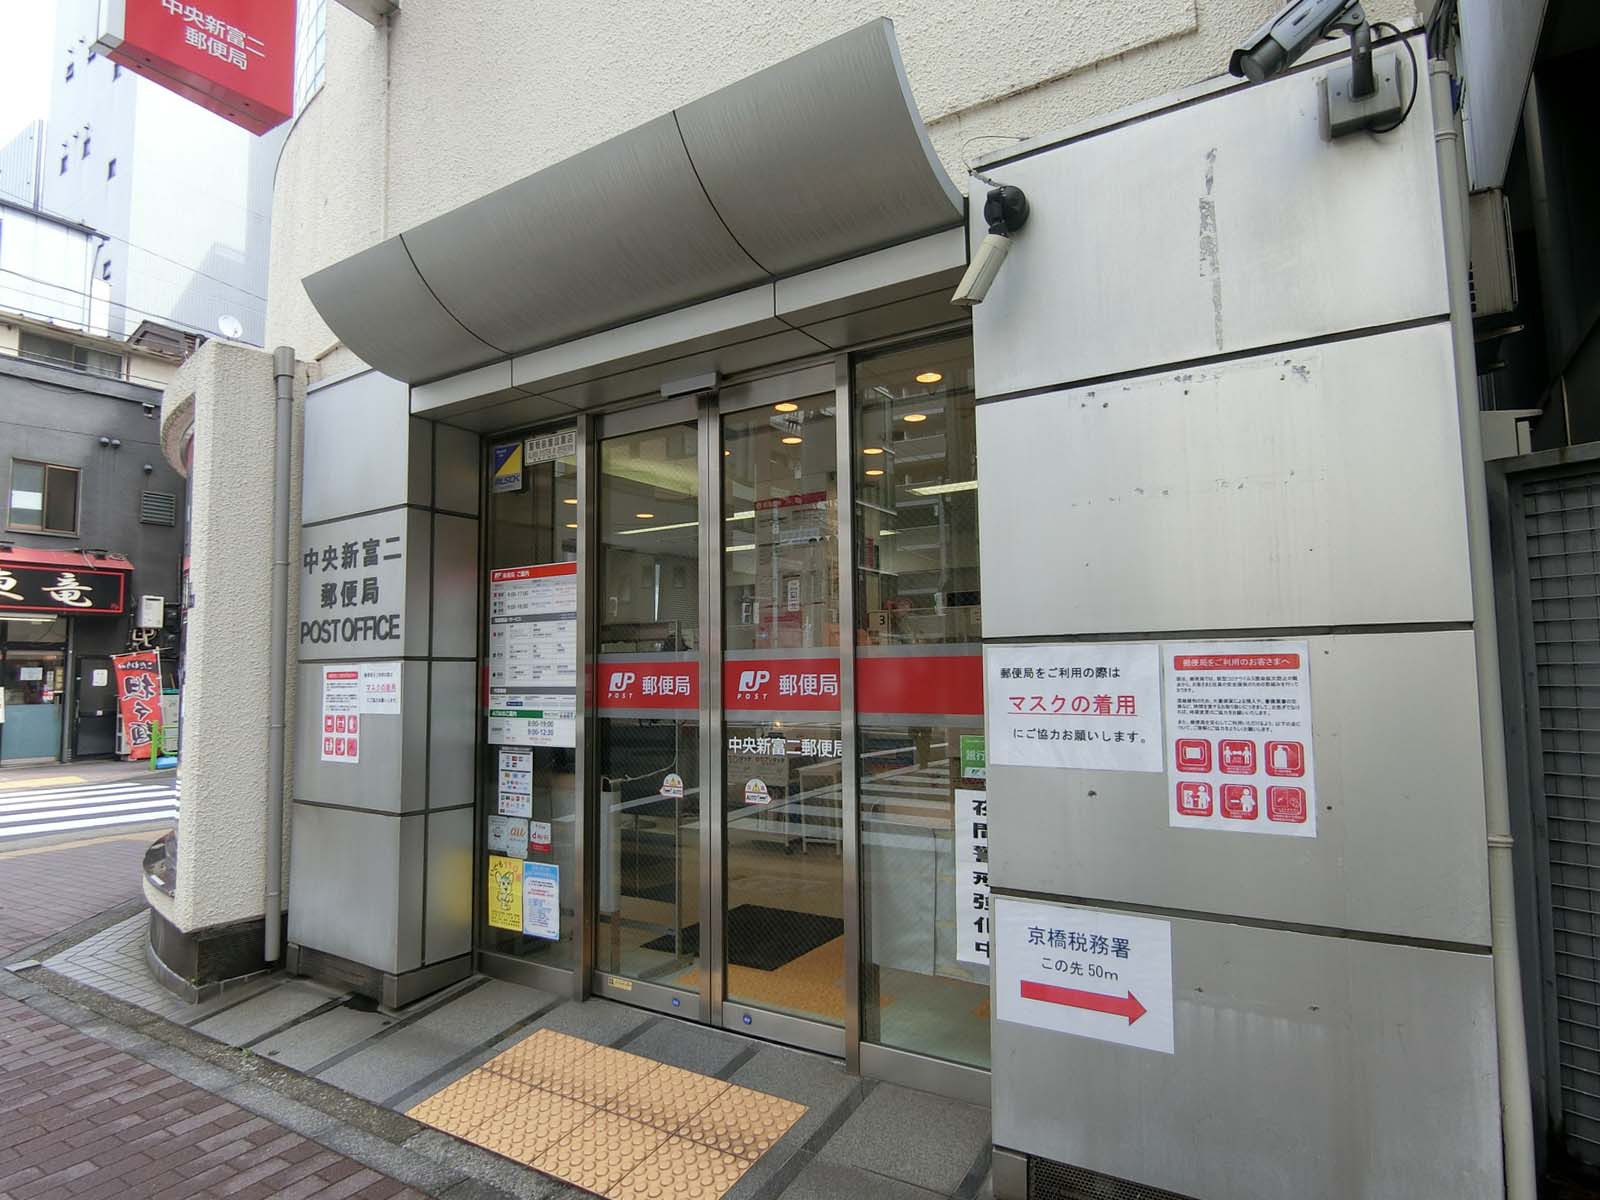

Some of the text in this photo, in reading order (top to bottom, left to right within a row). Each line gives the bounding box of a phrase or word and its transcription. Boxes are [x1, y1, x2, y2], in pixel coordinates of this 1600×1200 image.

[161, 0, 265, 57] 中央新富二
[184, 26, 247, 70] 郵便局
[303, 536, 402, 575] 中央新富二
[320, 577, 380, 609] 郵便局
[301, 614, 400, 644] POST OFFICE
[642, 675, 690, 696] 郵便局
[779, 674, 838, 696] 郵便局
[1000, 667, 1121, 679] 郵便局をご利用の際は
[1008, 694, 1137, 716] マスクの着用
[1013, 728, 1147, 744] にご協力お願いします。
[1027, 926, 1131, 959] 京橋税務署
